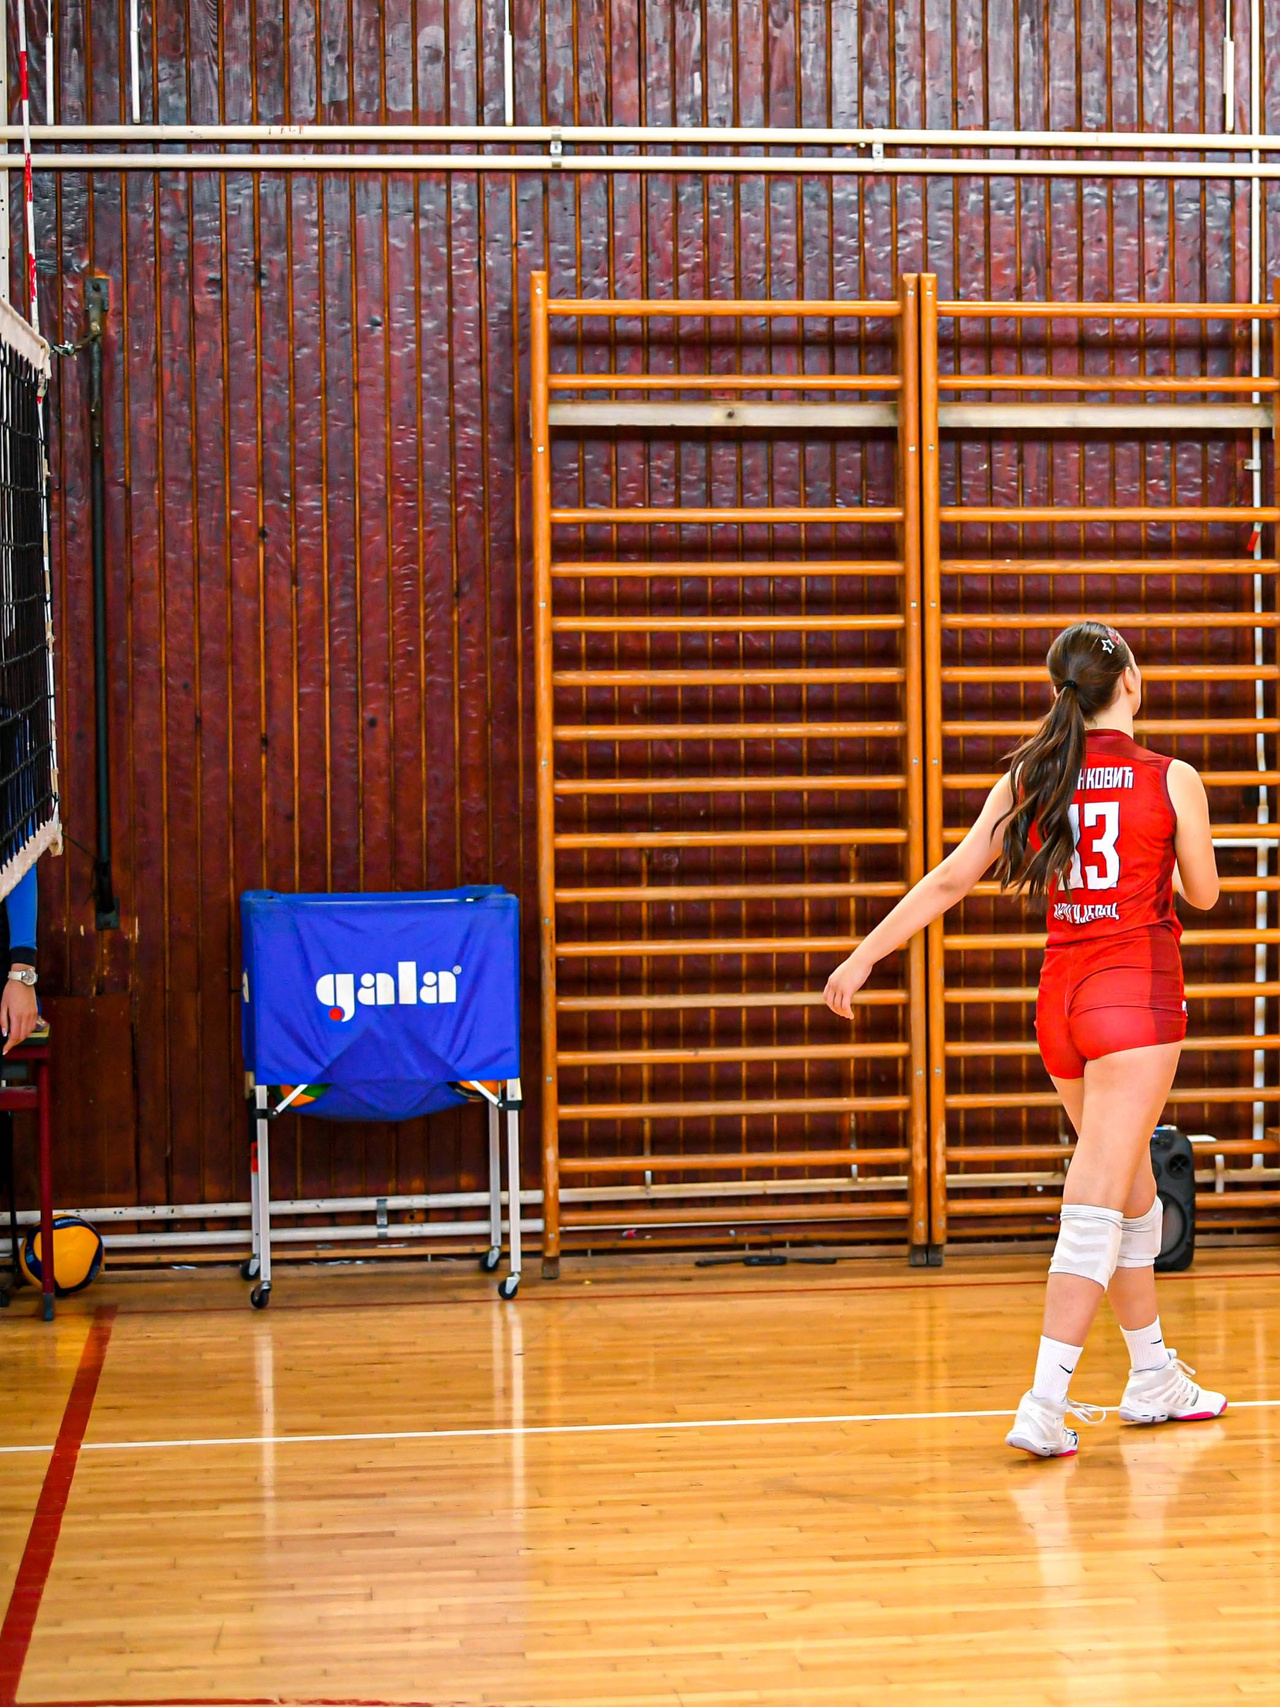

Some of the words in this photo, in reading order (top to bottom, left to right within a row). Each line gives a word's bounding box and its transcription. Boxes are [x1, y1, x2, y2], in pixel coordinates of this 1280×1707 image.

[1077, 766, 1134, 790] НКОВИЋ
[1058, 801, 1120, 892] 13
[315, 961, 457, 1022] gala
